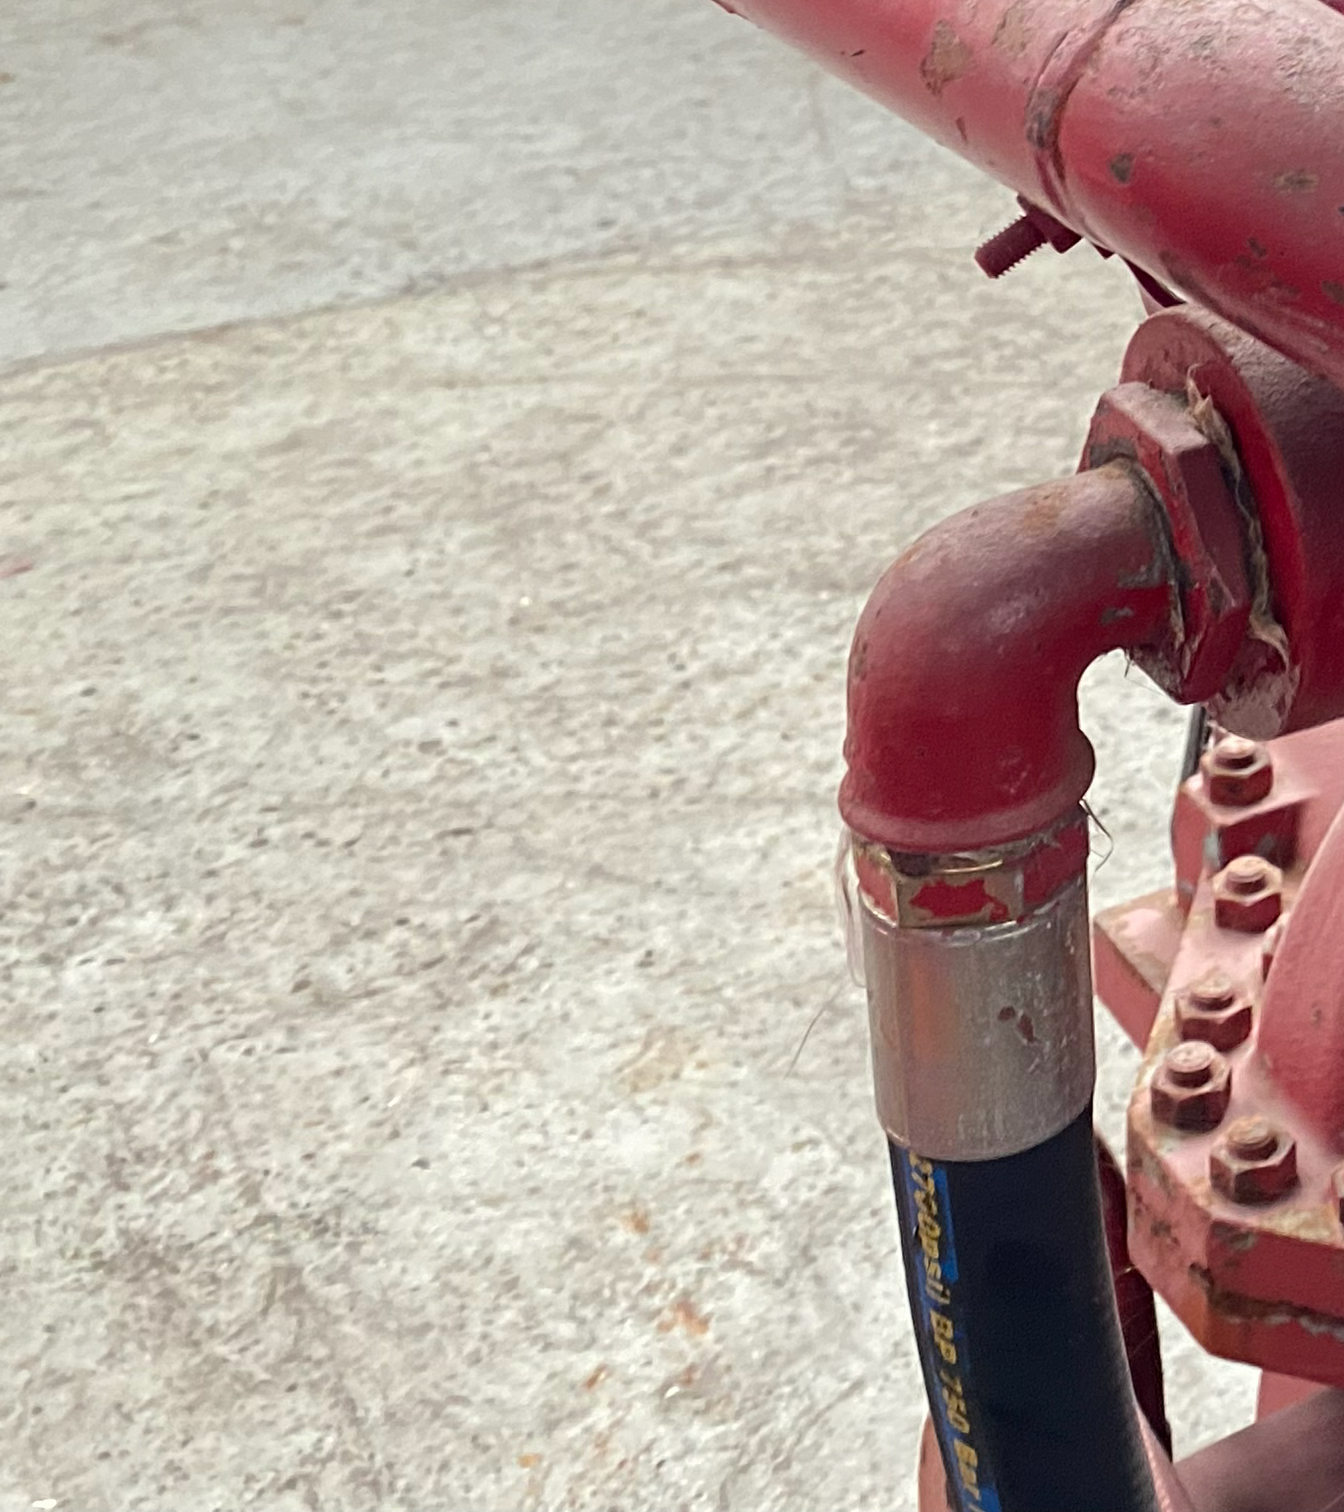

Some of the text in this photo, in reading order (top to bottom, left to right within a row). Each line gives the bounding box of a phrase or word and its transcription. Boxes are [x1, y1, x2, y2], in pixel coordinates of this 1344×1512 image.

[930, 1309, 957, 1365] BP
[939, 1368, 970, 1434] 750
[953, 1438, 980, 1501] Bar
